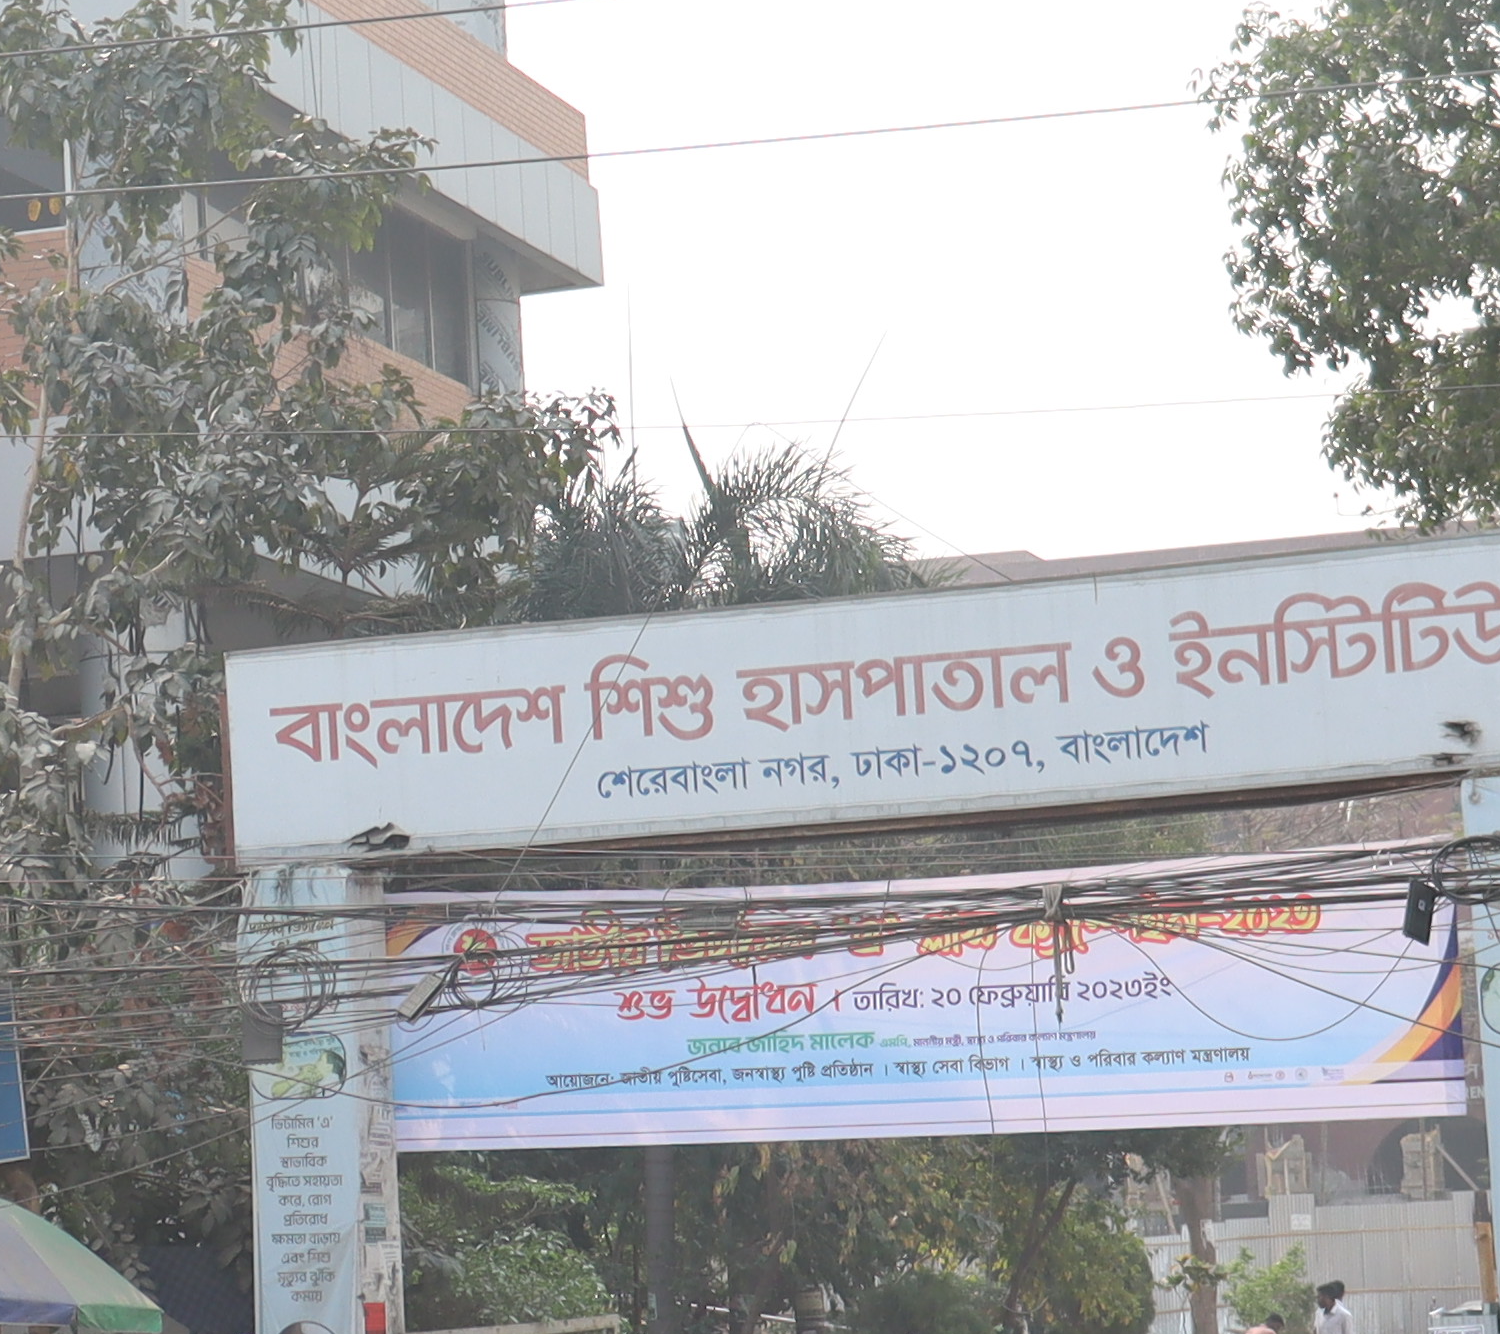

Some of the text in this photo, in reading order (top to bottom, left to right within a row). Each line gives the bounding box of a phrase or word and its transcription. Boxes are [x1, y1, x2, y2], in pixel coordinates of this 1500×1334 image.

[270, 684, 565, 768] বাংলাদেশ
[584, 654, 713, 742] শিশু
[736, 641, 1072, 731] হাসপাতাল
[1092, 637, 1145, 699] ও
[598, 755, 749, 799] শেরেবাংলা
[763, 752, 840, 789] নগর,
[1055, 719, 1208, 766] বাংলাদেশ
[616, 988, 680, 1021] শুভ
[688, 978, 818, 1024] উদ্বোধন
[930, 985, 964, 1008] ২০
[1077, 970, 1173, 1002] ২০২৩ইং
[810, 1029, 875, 1052] মালেক
[791, 1062, 818, 1083] পুষ্টি
[821, 1059, 874, 1078] প্রতিষ্ঠান
[932, 1058, 965, 1074] সেবা
[969, 1055, 1010, 1073] বিভাগ
[1088, 1050, 1137, 1068] পরিবার
[1142, 1050, 1186, 1066] কল্যাণ
[1190, 1046, 1251, 1064] মন্ত্রণালয়
[287, 1134, 319, 1149] শিশুর
[303, 1174, 343, 1189] সহায়তা
[308, 1193, 332, 1206] রোগ
[283, 1210, 328, 1226] প্রতিরোধ
[272, 1232, 340, 1246] ক্ষমতা বাড়ায়
[281, 1252, 305, 1265] এবং
[291, 1290, 323, 1304] কমায়
